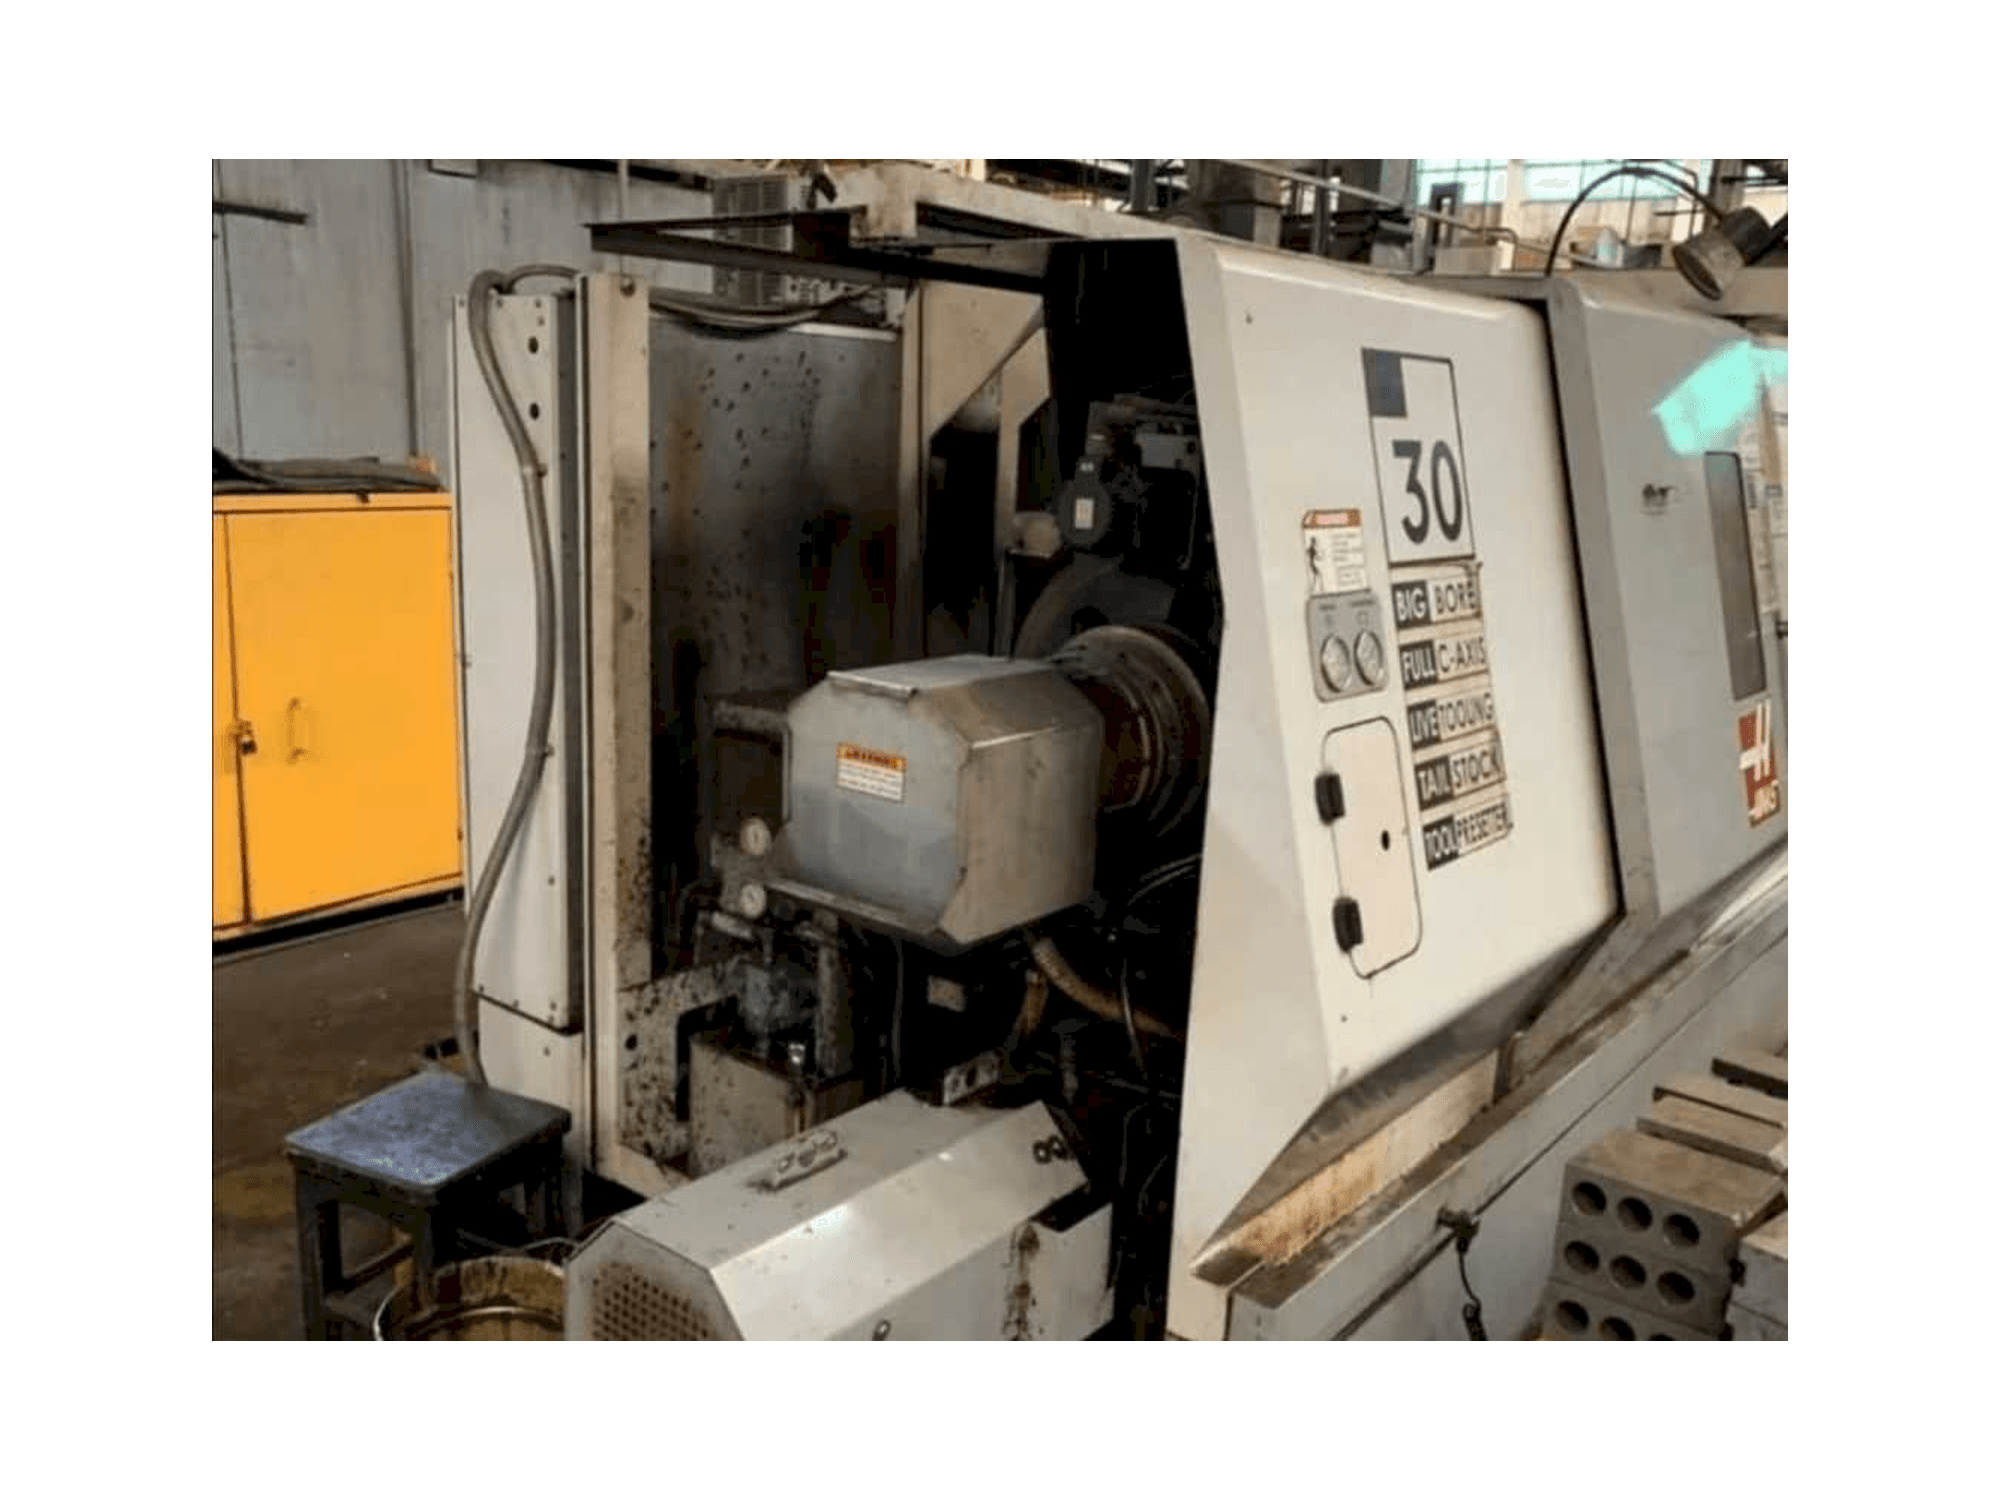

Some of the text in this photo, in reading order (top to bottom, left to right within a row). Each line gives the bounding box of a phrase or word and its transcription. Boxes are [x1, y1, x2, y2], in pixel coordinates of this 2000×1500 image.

[1391, 439, 1463, 545] 30
[1395, 580, 1477, 621] BIG BORE
[1402, 637, 1486, 683] FULL C-AXIS
[1409, 692, 1494, 742] LIVE TOOLING
[1418, 748, 1502, 801] TAIL STOCK
[1425, 825, 1459, 861] TOOL
